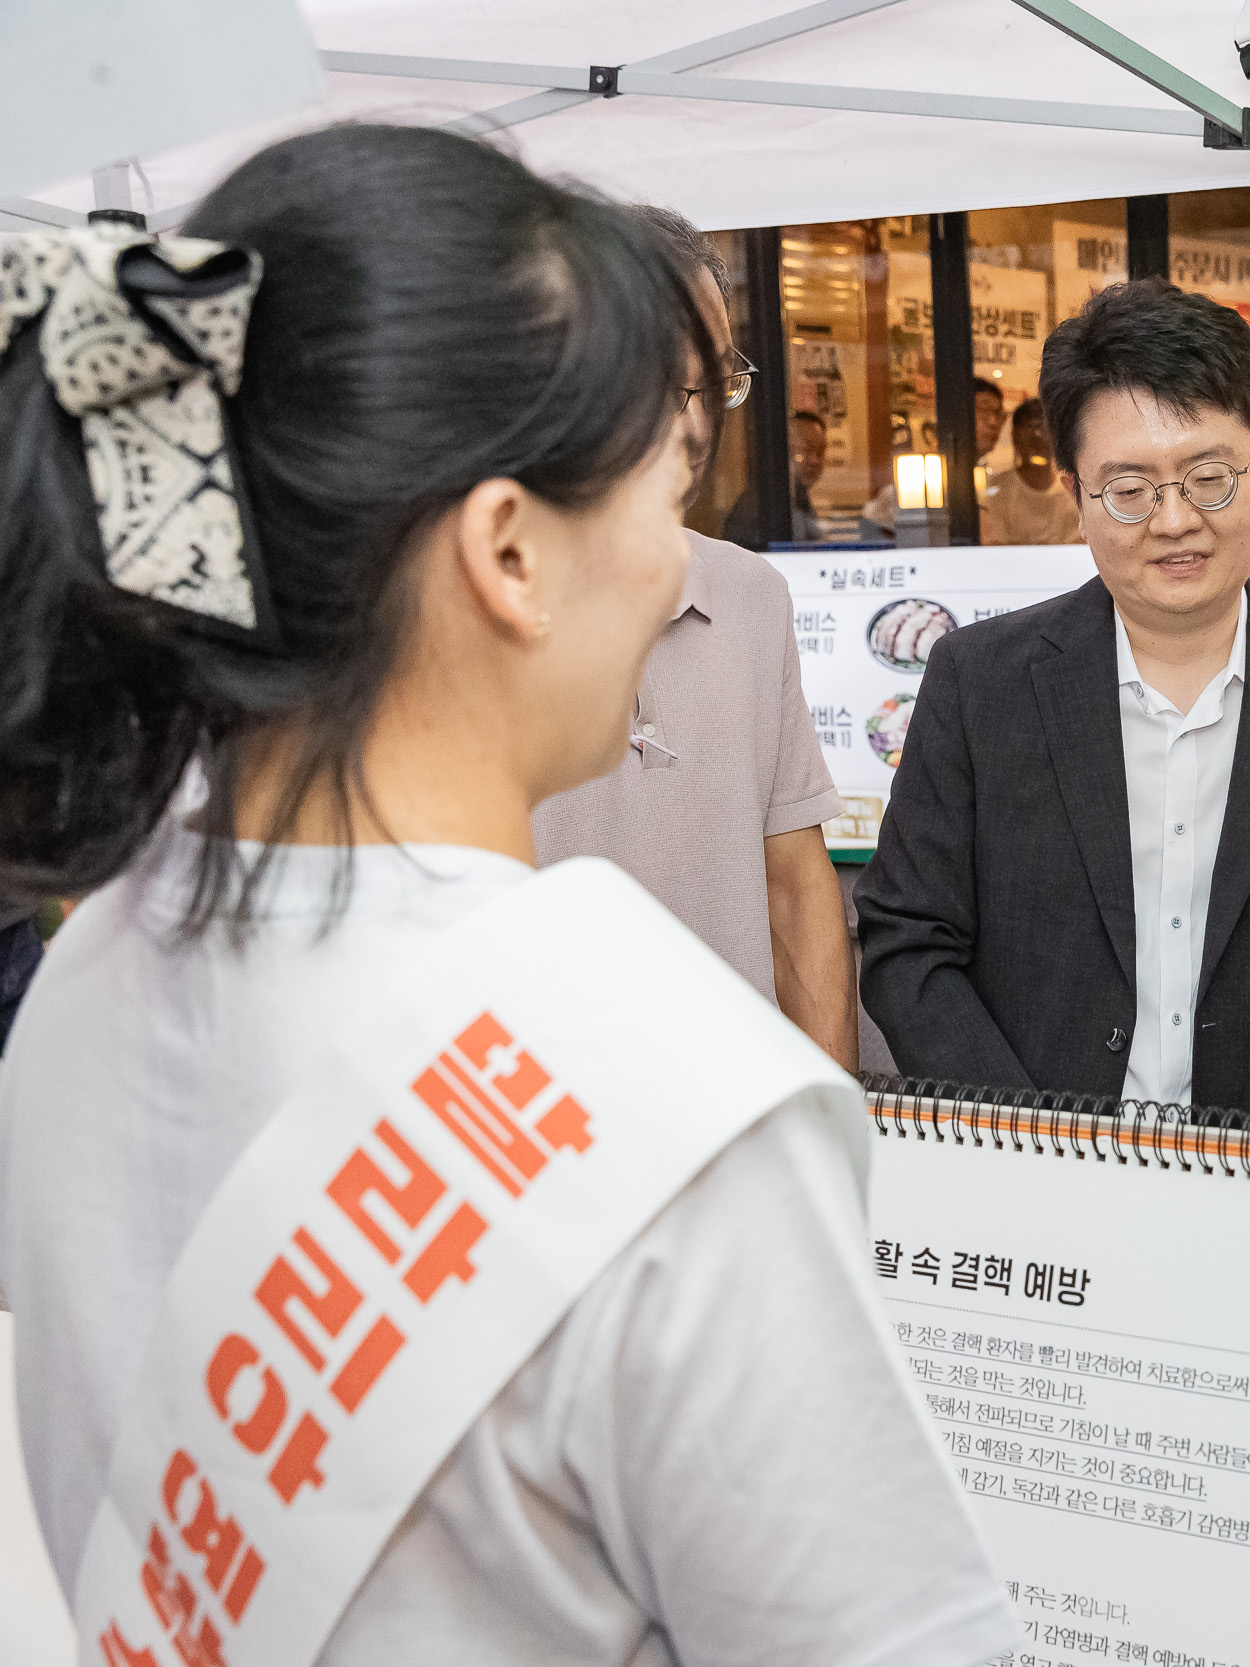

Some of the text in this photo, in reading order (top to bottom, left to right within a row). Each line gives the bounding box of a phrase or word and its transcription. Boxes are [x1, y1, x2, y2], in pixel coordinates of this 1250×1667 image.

[911, 1246, 942, 1286] 속
[950, 1250, 1013, 1296] 결핵
[1023, 1261, 1091, 1307] 예방
[891, 1321, 1250, 1398] 한 것은 결핵 환자를 빨리 발견하여 치료함으로써
[908, 1356, 1087, 1405] 되는 것을 막는 것입니다.
[973, 1402, 1055, 1434] 전파되므로
[1058, 1418, 1109, 1445] 기침이
[1113, 1426, 1131, 1449] 날
[1135, 1431, 1152, 1451] 때
[1156, 1434, 1191, 1459] 주변
[975, 1437, 1023, 1465] 예절을
[1027, 1448, 1077, 1474] 지키는
[1081, 1456, 1115, 1481] 것이
[1119, 1463, 1208, 1498] 중요합니다.
[971, 1471, 1008, 1496] 감기,
[1012, 1478, 1062, 1506] 독감과
[1065, 1488, 1099, 1514] 같은
[1102, 1496, 1137, 1521] 다른
[1140, 1502, 1194, 1531] 호흡기
[1197, 1514, 1250, 1542] 감염병
[1023, 1584, 1057, 1610] 주는
[1060, 1593, 1131, 1626] 것입니다.
[1043, 1624, 1111, 1657] 감염병과
[1115, 1639, 1149, 1667] 결핵
